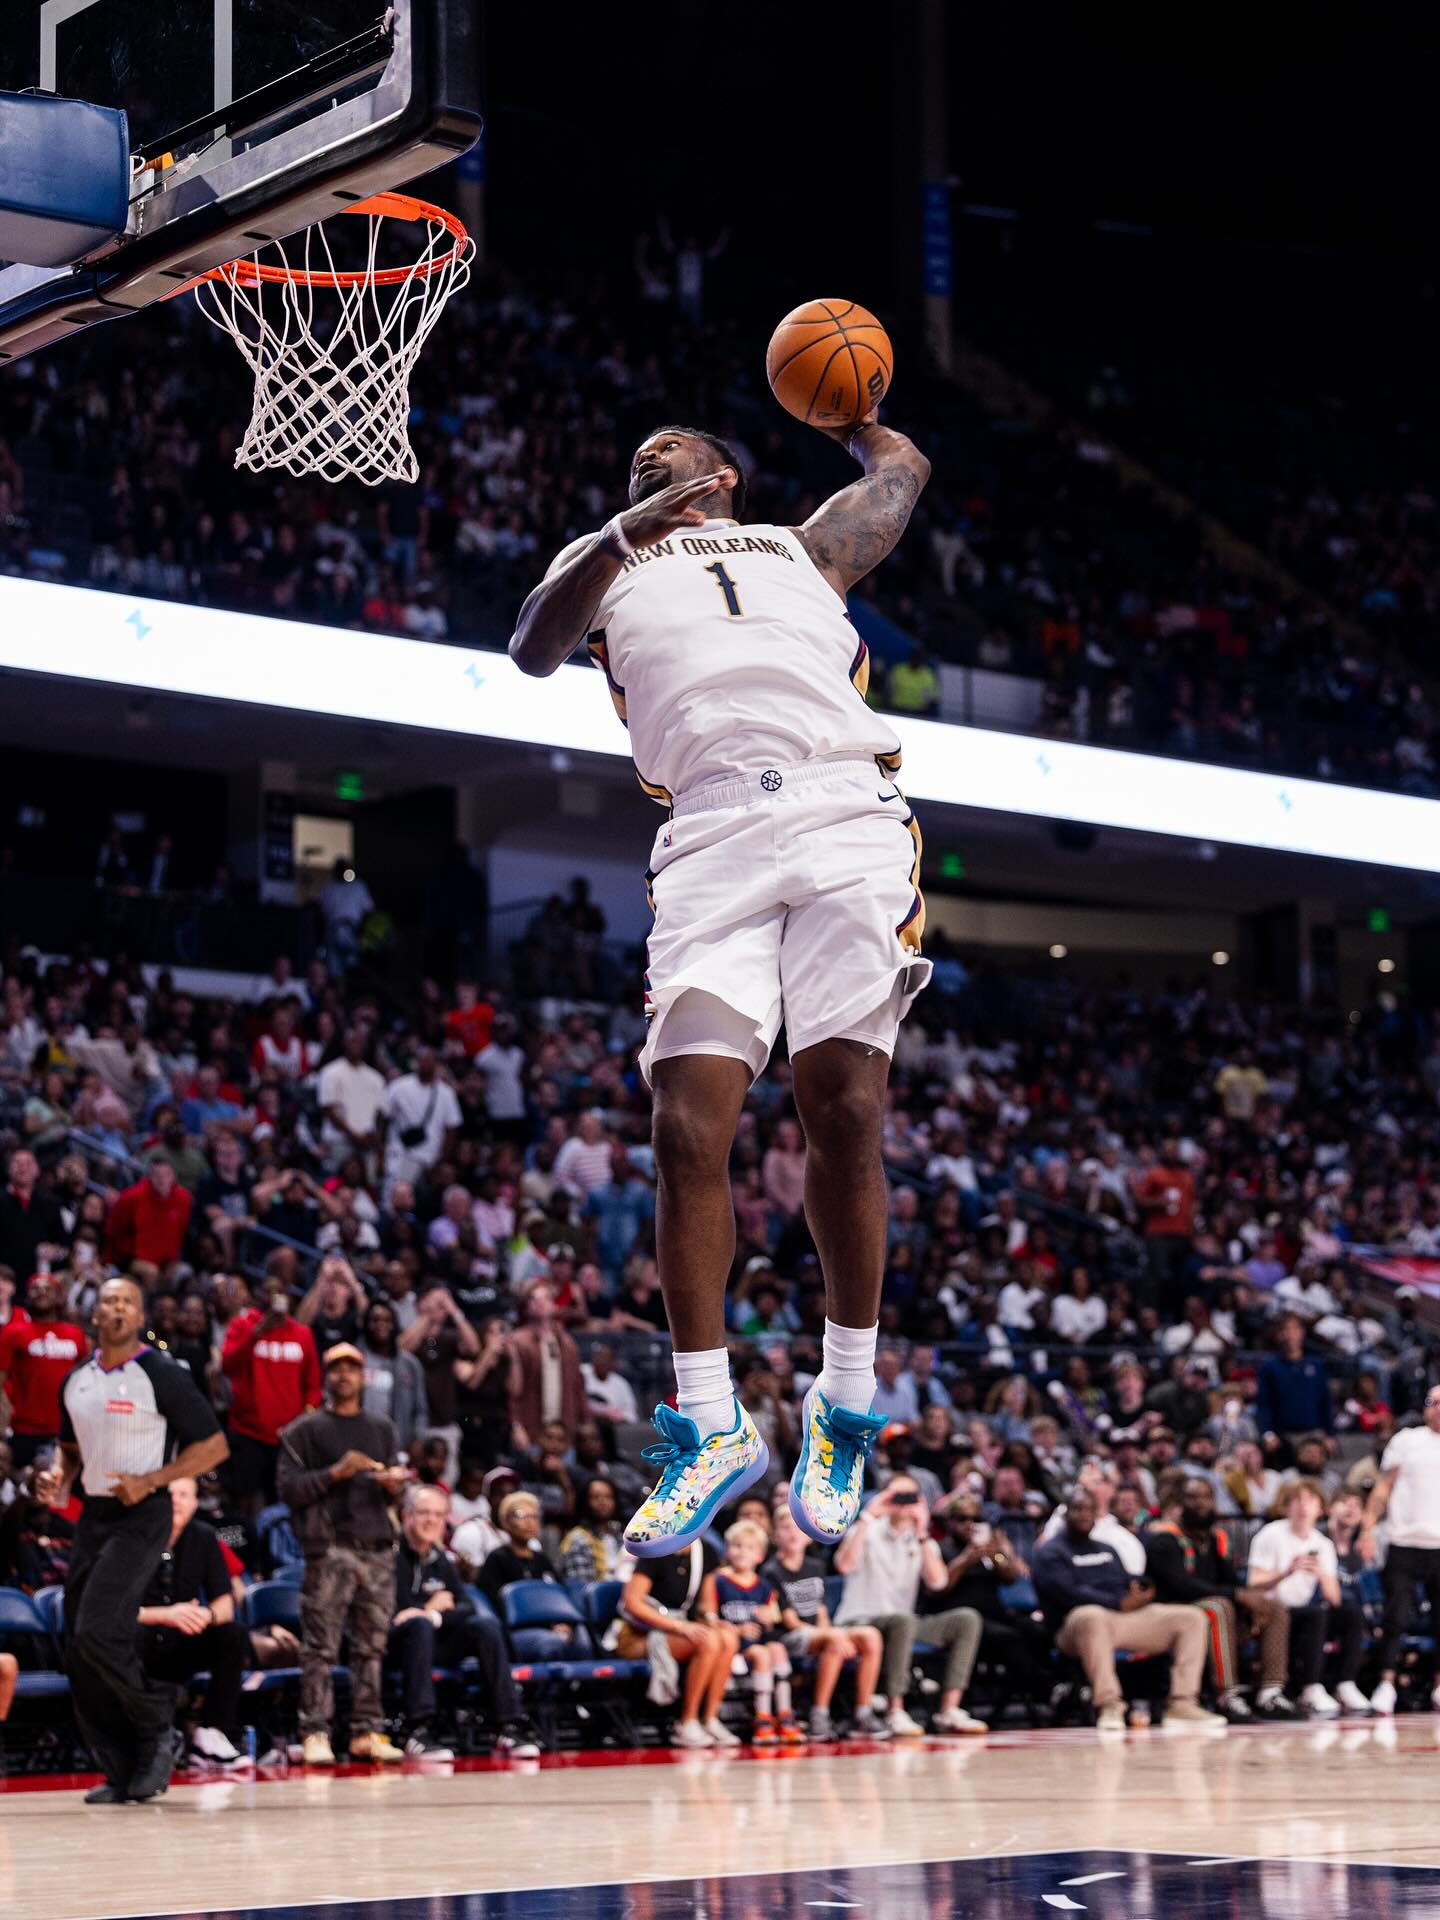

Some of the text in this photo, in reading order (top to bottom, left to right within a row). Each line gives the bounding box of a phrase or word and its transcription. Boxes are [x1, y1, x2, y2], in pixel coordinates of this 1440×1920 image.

[623, 537, 796, 573] NEW ORLEANS
[704, 561, 744, 617] 1
